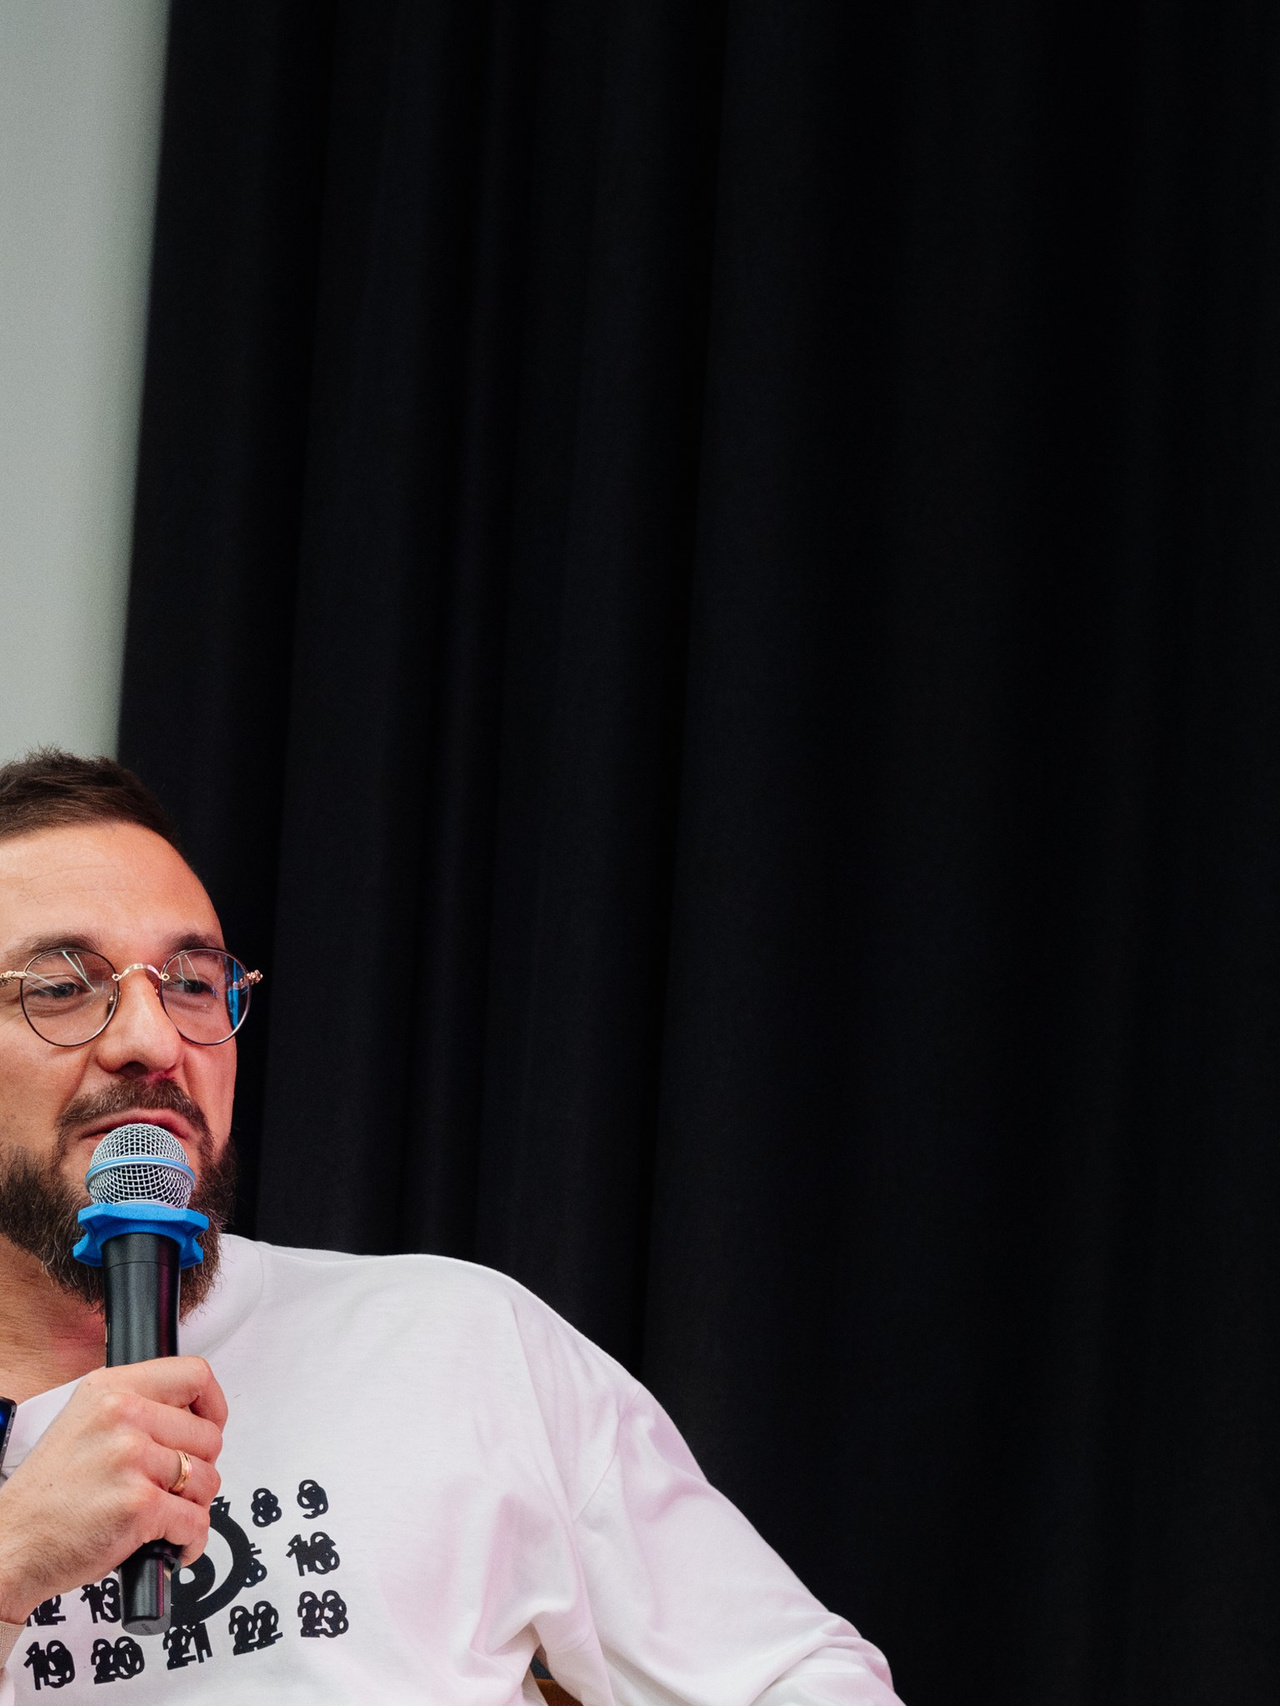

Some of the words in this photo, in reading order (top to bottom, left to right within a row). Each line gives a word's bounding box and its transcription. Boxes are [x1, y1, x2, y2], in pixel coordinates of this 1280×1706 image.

[23, 1640, 76, 1691] 19
[91, 1635, 145, 1685] 20
[228, 1600, 284, 1656] 22
